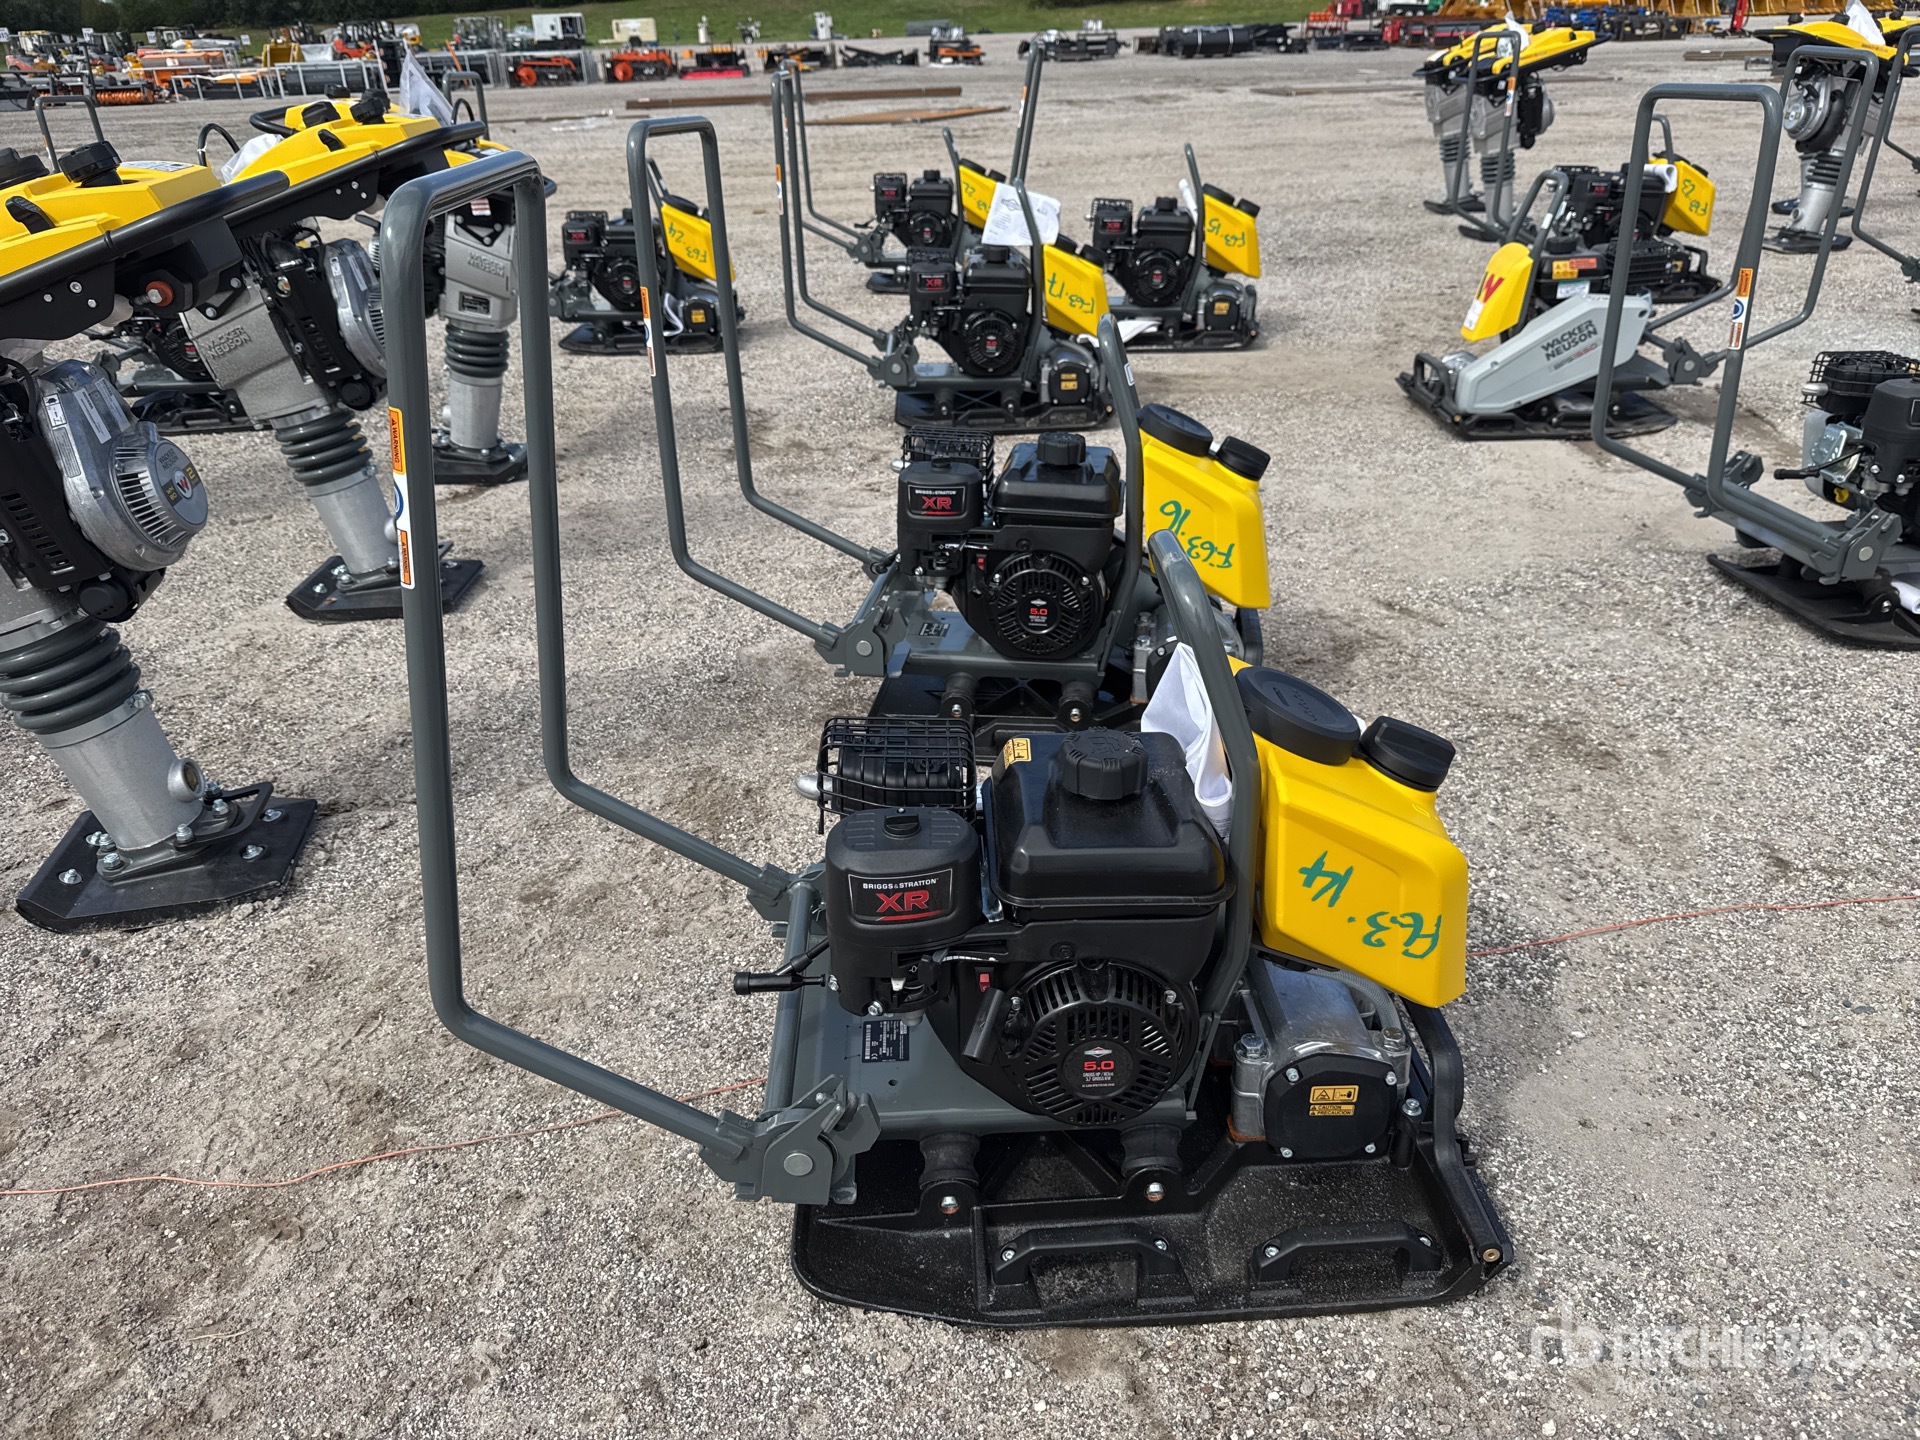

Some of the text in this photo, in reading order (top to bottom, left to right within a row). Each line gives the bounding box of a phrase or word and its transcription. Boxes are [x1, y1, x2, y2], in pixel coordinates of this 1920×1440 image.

[208, 332, 252, 359] NEUSON
[1541, 320, 1594, 352] WACKER
[1545, 327, 1598, 361] NEUSON
[922, 496, 952, 509] XR
[1030, 608, 1048, 616] 5.0
[875, 890, 930, 913] XR
[1083, 1060, 1115, 1071] 5.0
